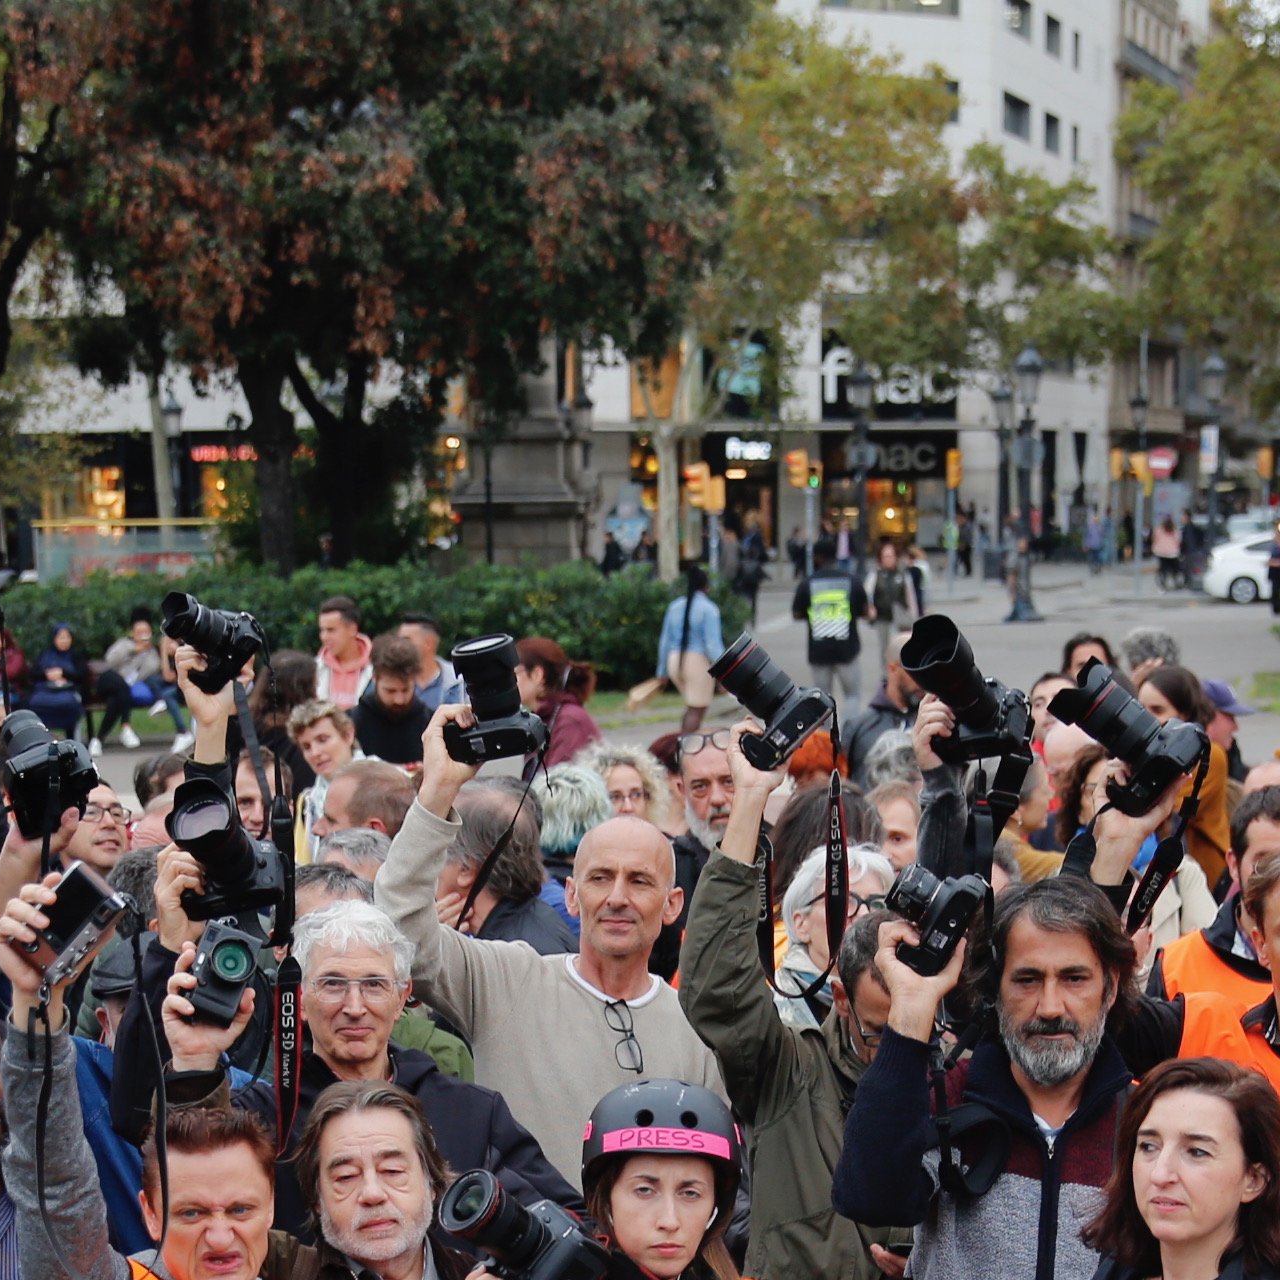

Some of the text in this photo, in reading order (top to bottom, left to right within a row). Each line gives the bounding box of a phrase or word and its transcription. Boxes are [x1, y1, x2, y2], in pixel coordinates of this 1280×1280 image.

[1137, 871, 1163, 913] Canon
[281, 991, 295, 1028] EOS
[282, 1032, 295, 1051] 5D
[282, 1053, 291, 1077] Mark
[620, 1129, 705, 1149] PRESS
